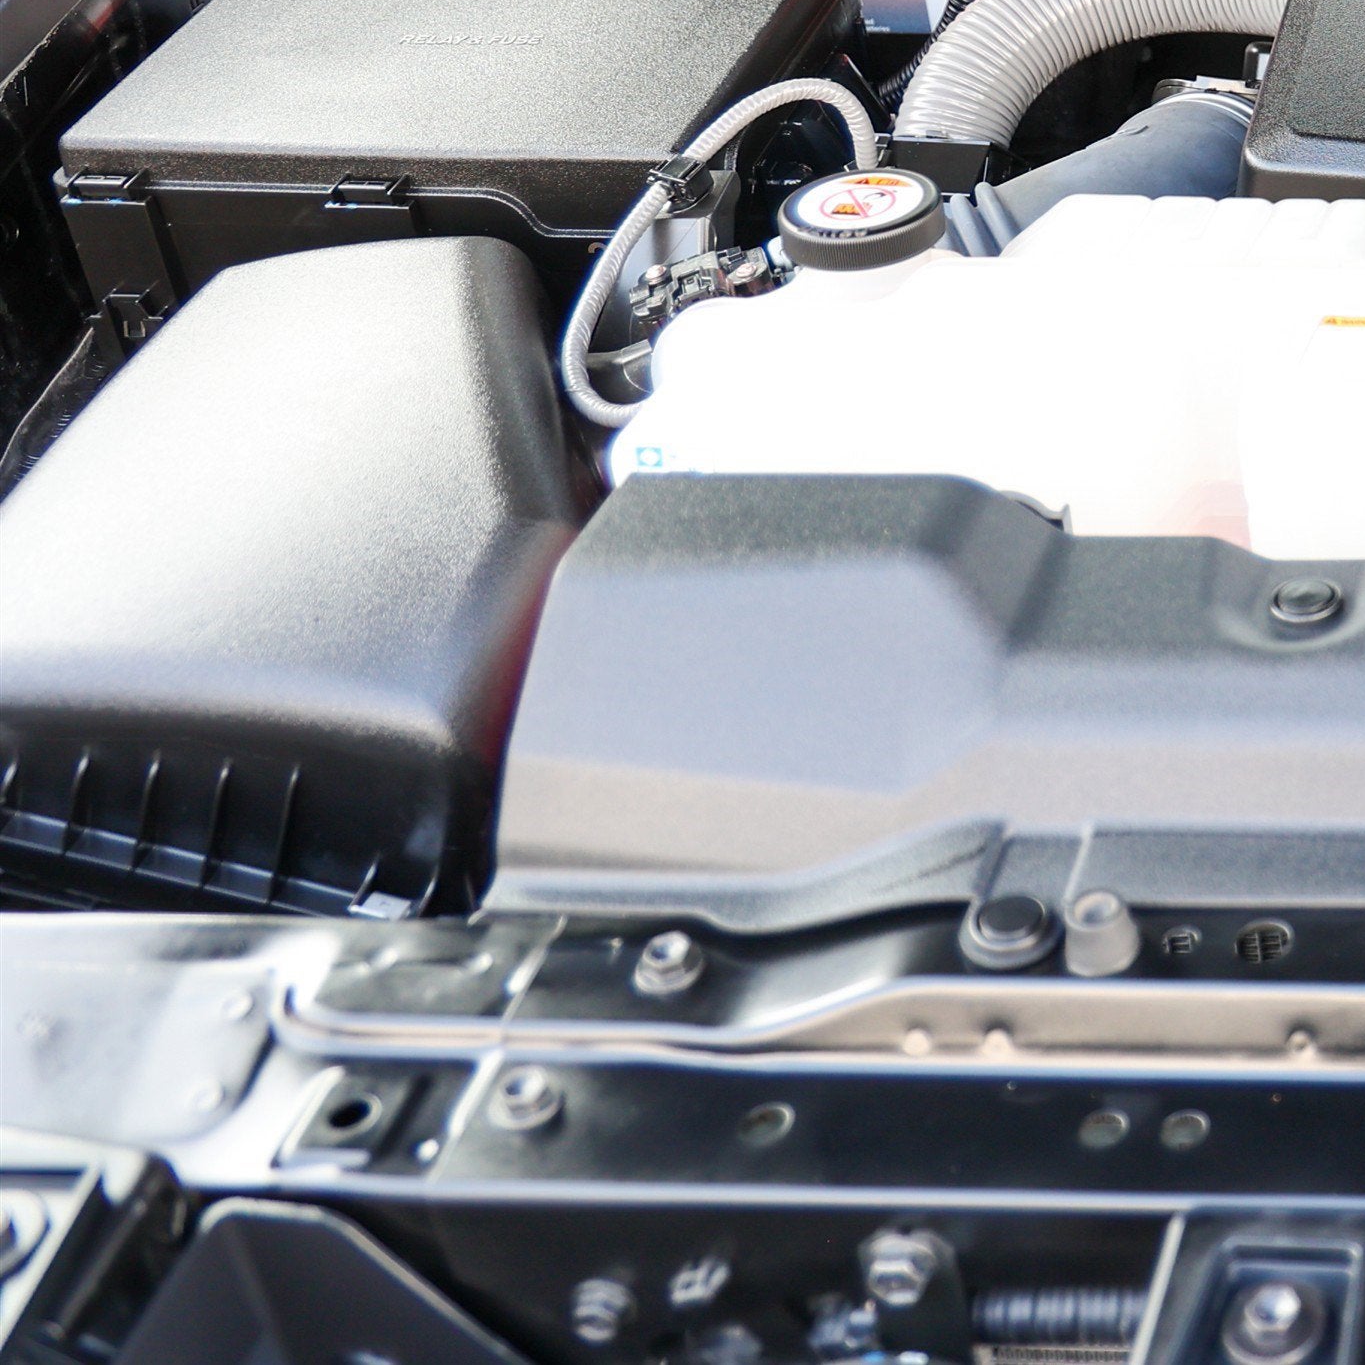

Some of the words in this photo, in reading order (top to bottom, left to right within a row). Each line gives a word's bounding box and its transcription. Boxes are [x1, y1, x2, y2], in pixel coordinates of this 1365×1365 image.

[399, 34, 470, 46] RELAY
[470, 35, 484, 46] &
[487, 34, 545, 46] FUSE
